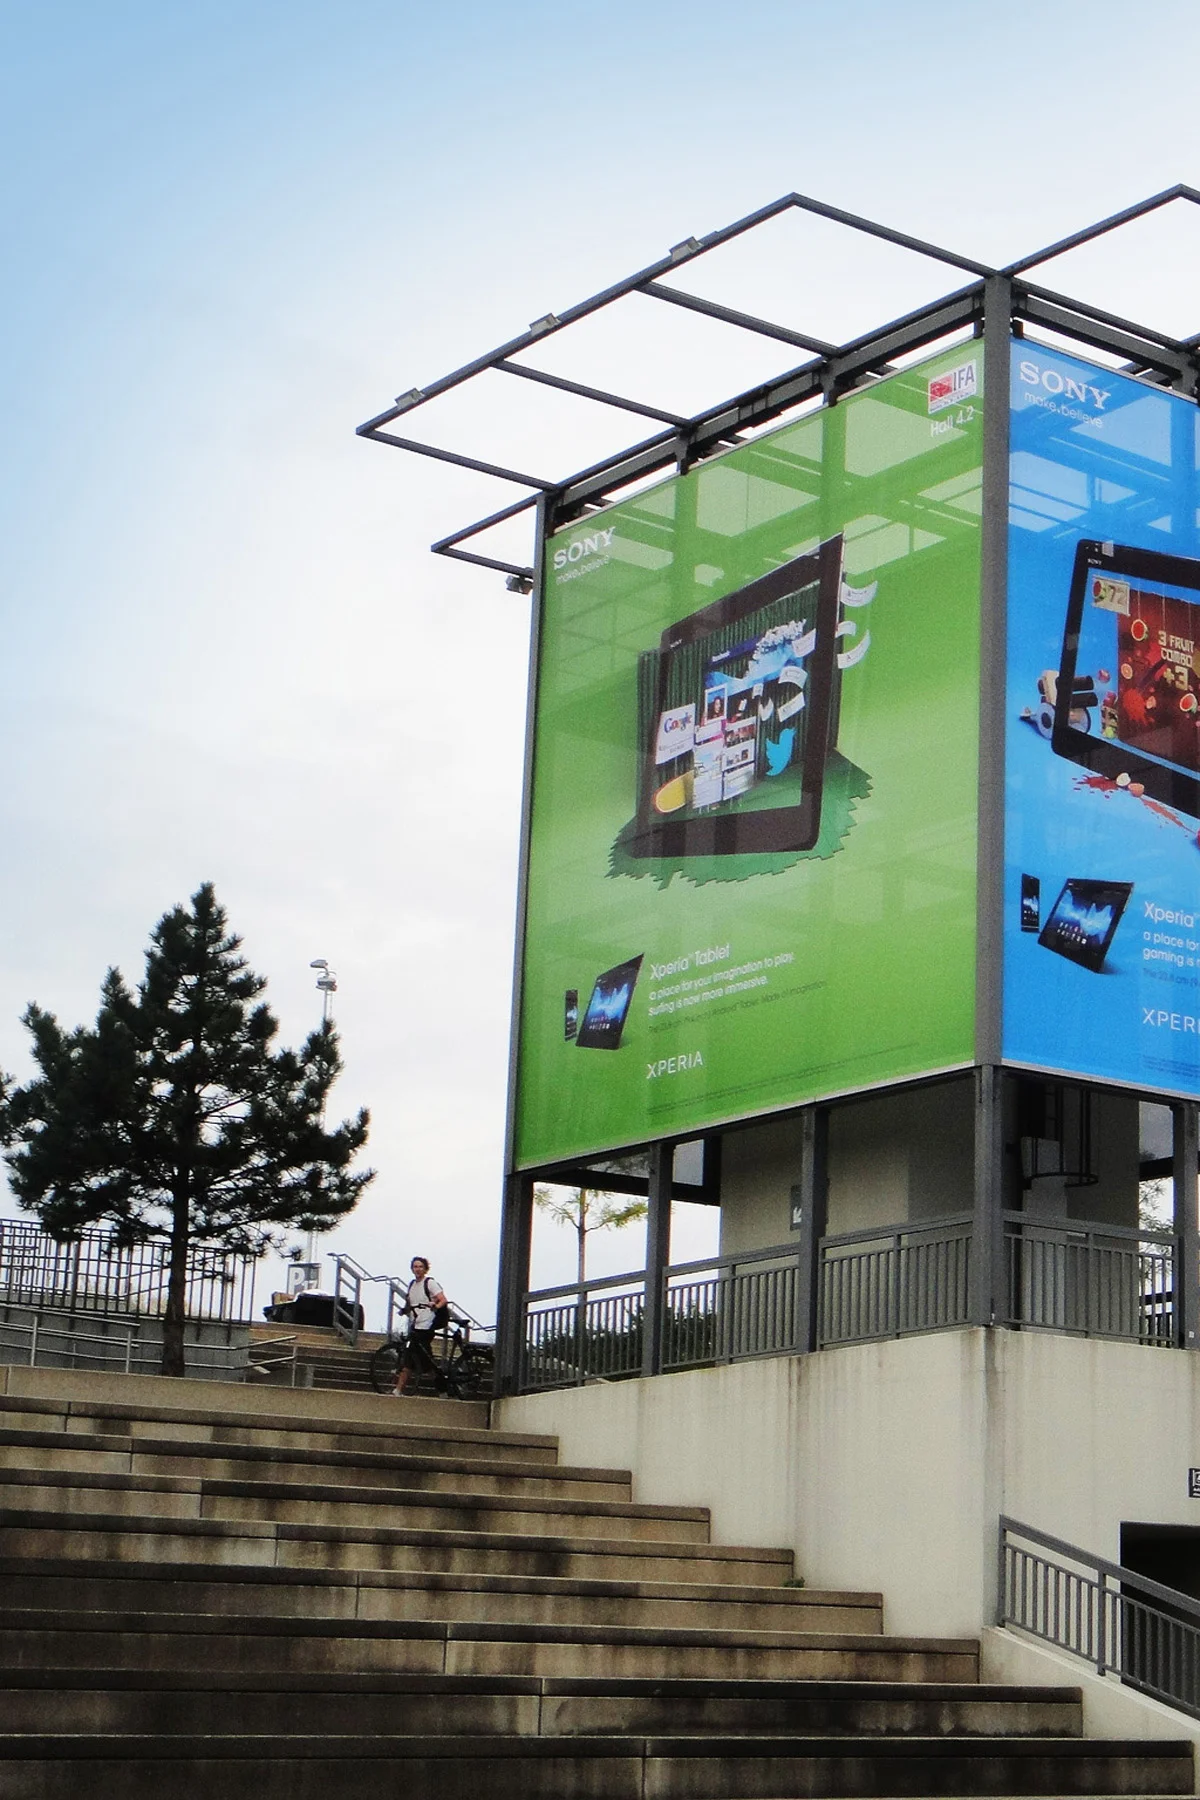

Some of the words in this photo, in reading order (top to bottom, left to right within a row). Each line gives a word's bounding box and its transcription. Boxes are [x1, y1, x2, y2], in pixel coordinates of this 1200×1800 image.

[953, 364, 975, 391] IFA
[1020, 361, 1111, 410] SONY
[930, 414, 954, 437] Hall
[956, 405, 974, 425] 4.2
[553, 526, 616, 570] SONY
[1158, 630, 1167, 646] 3
[1169, 634, 1195, 654] FRUIT
[1161, 647, 1193, 668] COMBO
[1153, 932, 1184, 948] place
[1186, 938, 1199, 951] for
[695, 942, 730, 967] Tablet
[1143, 948, 1184, 967] gaming
[1187, 957, 1195, 967] is
[713, 960, 763, 984] imagination
[646, 1051, 704, 1079] XPERIA
